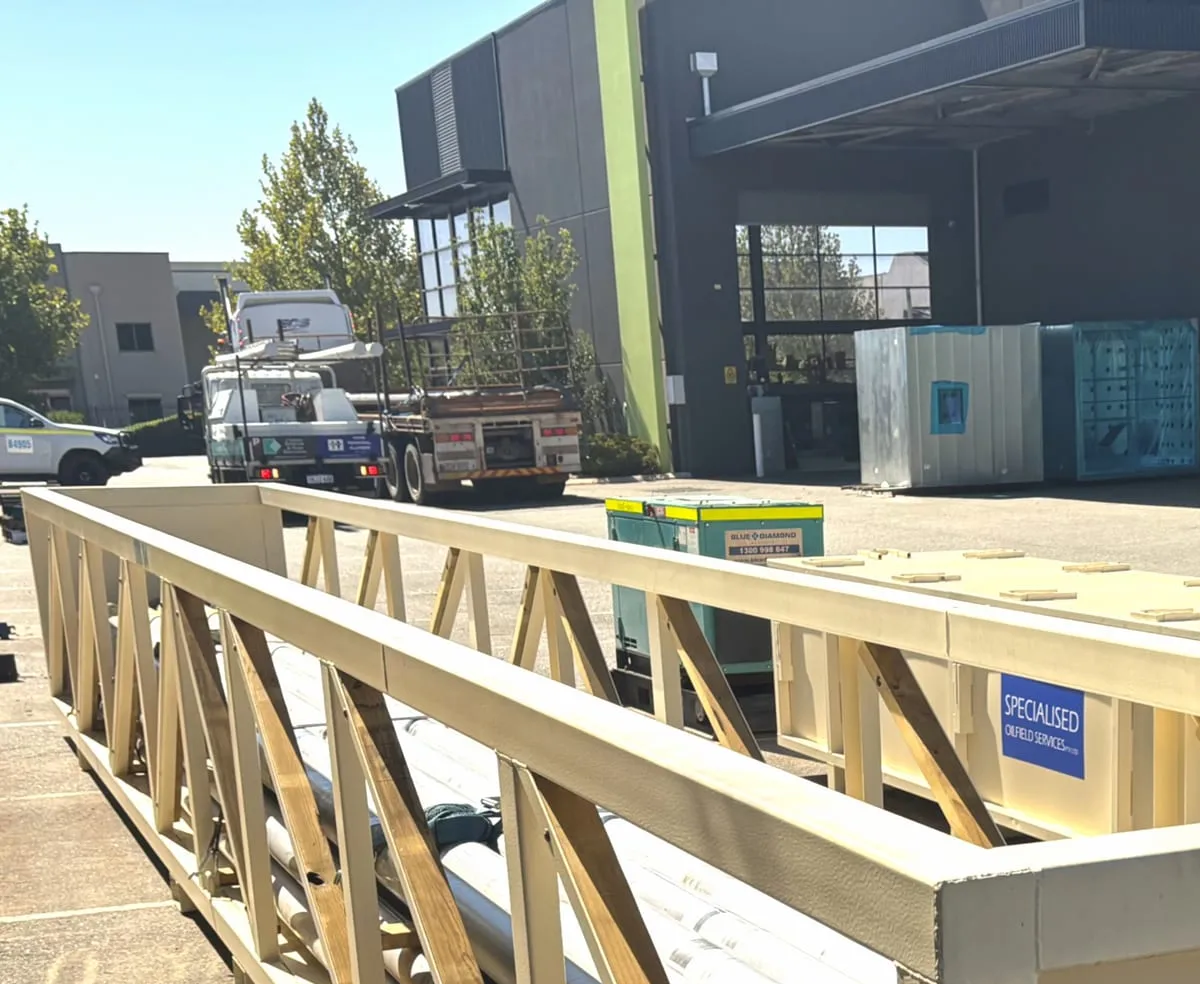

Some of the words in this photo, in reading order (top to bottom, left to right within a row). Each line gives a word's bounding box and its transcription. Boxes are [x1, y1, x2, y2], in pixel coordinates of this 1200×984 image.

[760, 531, 797, 540] DIAMOND
[1004, 693, 1080, 733] SPECIALISED
[1004, 723, 1034, 742] OILFIELD
[1034, 731, 1065, 751] SERVICES
